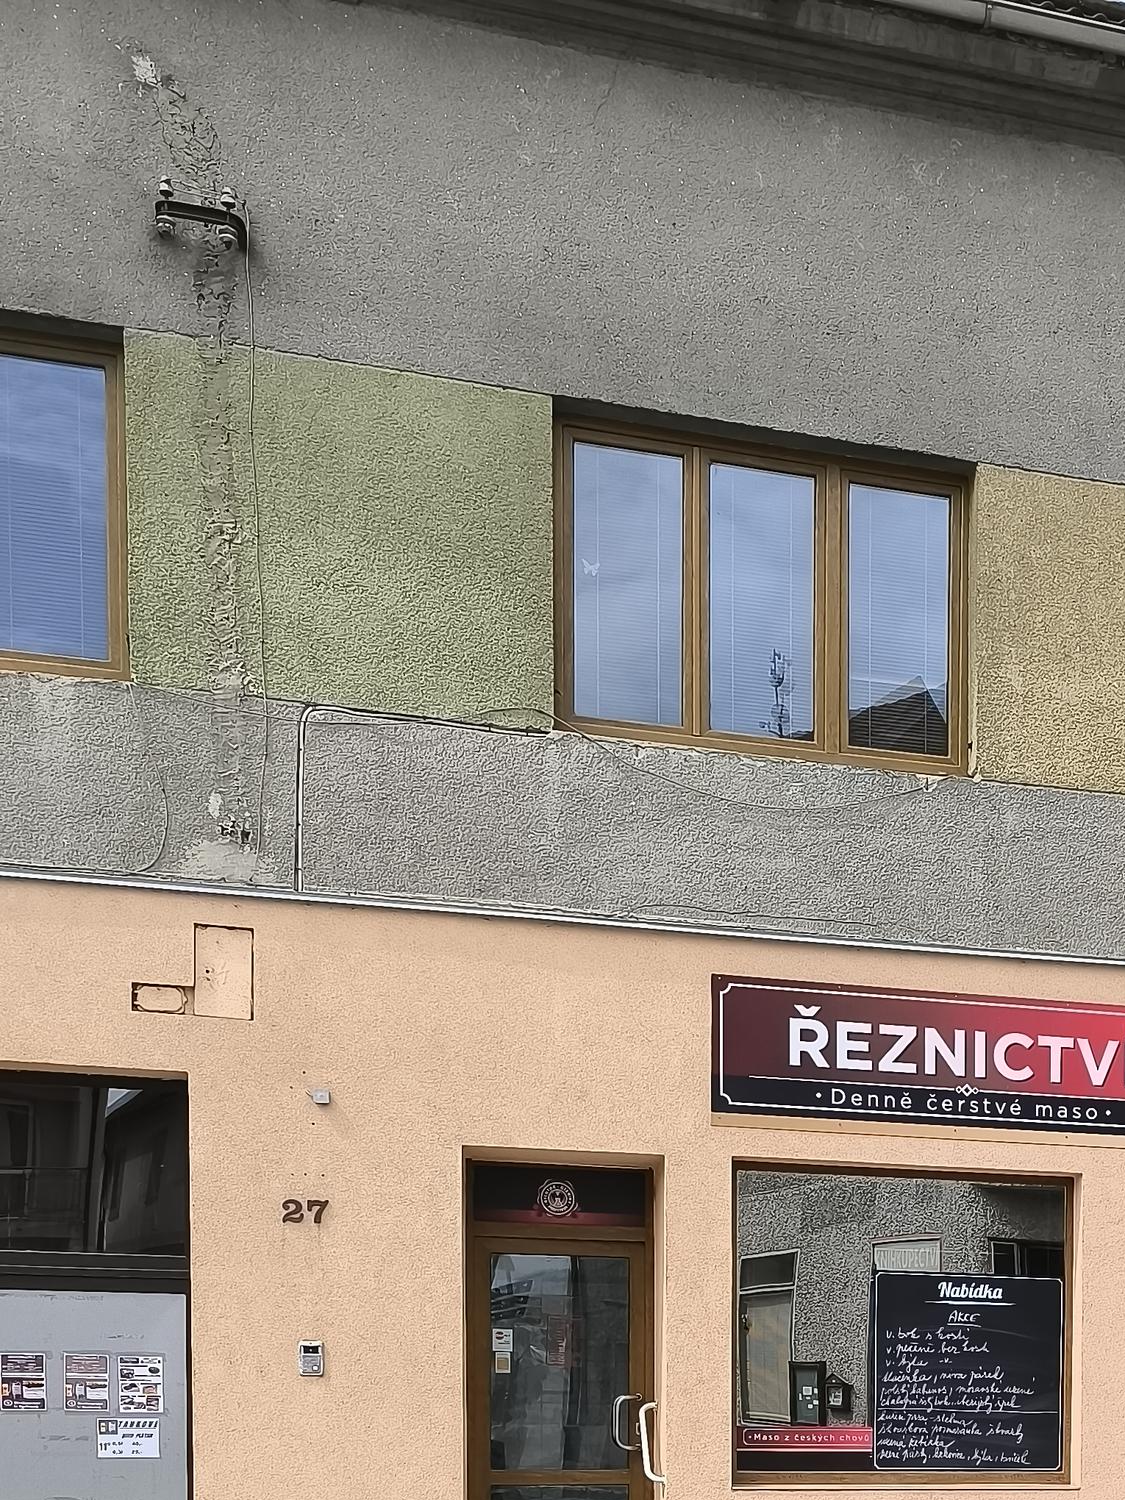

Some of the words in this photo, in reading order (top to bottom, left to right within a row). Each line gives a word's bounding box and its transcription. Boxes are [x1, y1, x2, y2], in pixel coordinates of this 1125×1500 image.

[830, 1087, 913, 1111] Denně
[926, 1092, 1022, 1116] čerstvé
[1035, 1104, 1098, 1121] maso
[282, 1199, 329, 1224] 27
[938, 1282, 1003, 1300] Nabídka
[948, 1310, 981, 1323] AKCE
[754, 1433, 780, 1441] Maso
